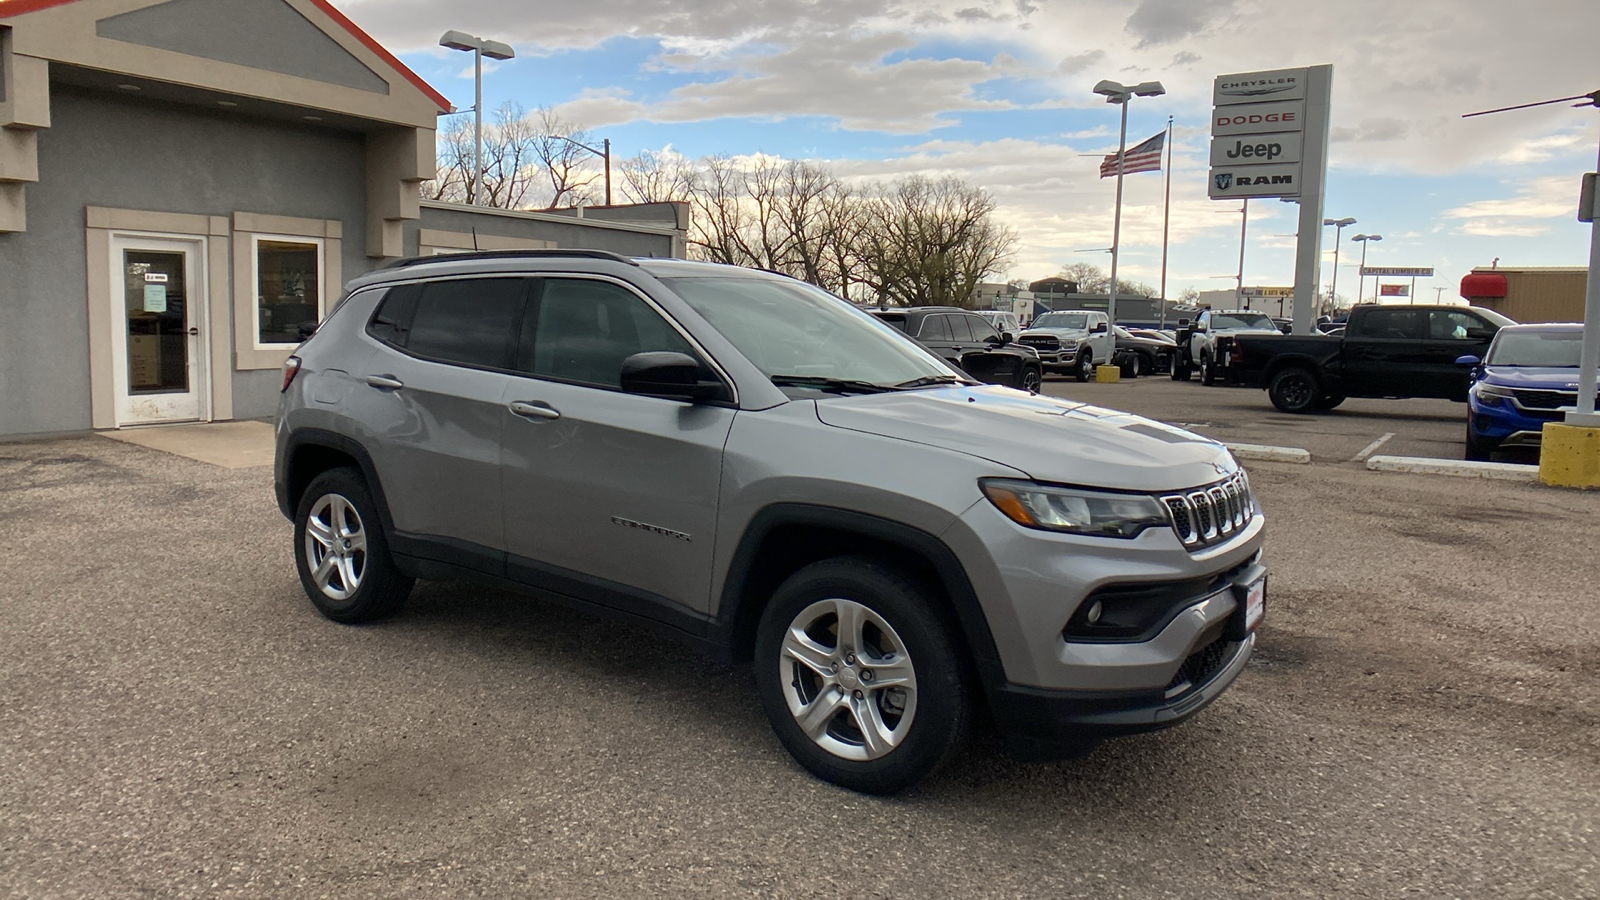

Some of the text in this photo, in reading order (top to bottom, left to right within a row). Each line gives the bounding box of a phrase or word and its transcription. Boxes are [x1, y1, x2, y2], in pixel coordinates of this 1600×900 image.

[1221, 77, 1296, 89] CHRYSLER
[1217, 112, 1295, 126] DODGE
[1226, 140, 1282, 160] Jeep
[1236, 175, 1293, 186] RAM
[1363, 267, 1390, 275] CAPITAL
[1392, 267, 1419, 275] LUMBER
